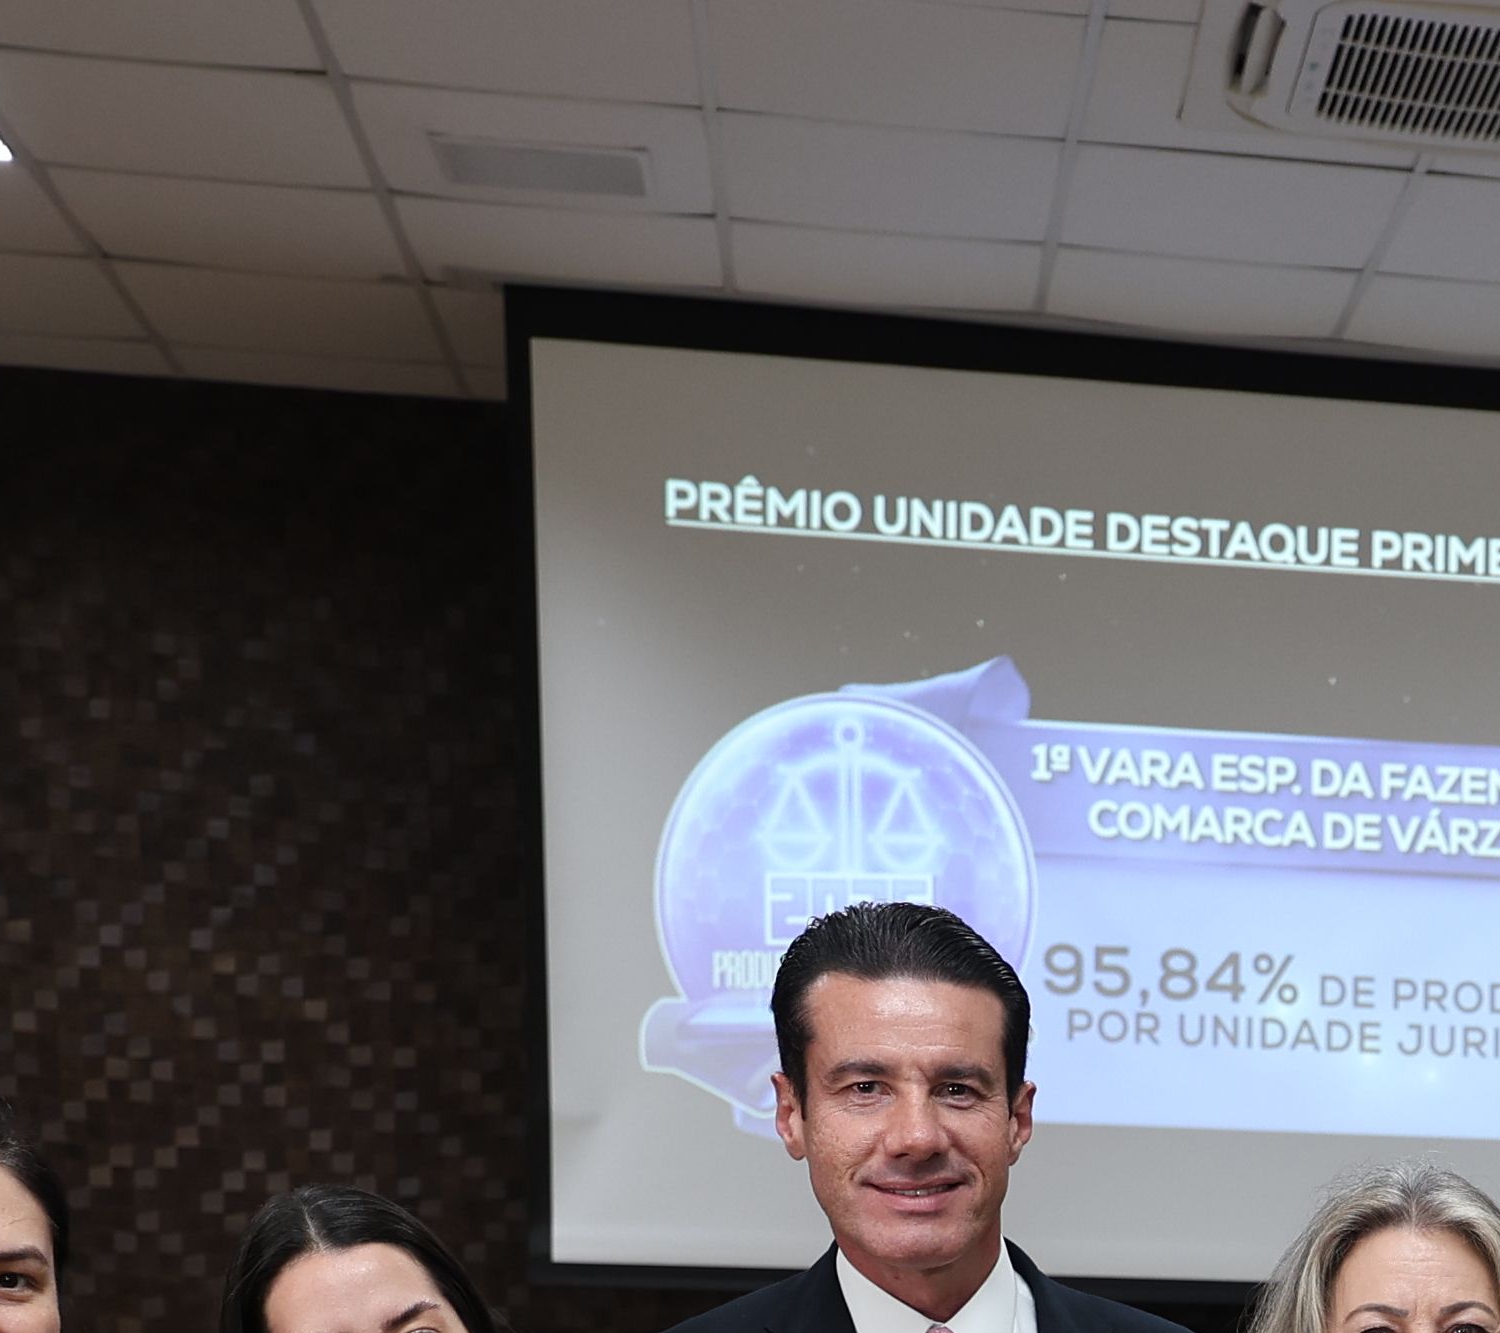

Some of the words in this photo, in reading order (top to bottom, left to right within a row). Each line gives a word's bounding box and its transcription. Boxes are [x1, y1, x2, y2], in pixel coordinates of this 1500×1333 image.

[666, 475, 862, 532] PRÊMIO
[873, 494, 1094, 549] UNIDADE
[1106, 511, 1359, 566] DESTAQUE
[1077, 746, 1204, 790] VARA
[1212, 753, 1302, 795] ESP.
[1311, 758, 1374, 799] DA
[1088, 799, 1316, 848] COMARCA
[1323, 812, 1382, 851] DE
[1043, 943, 1298, 1007] 95,84%
[1319, 975, 1376, 1008] DE
[1067, 1008, 1160, 1045] POR
[1179, 1013, 1382, 1054] UNIDADE
